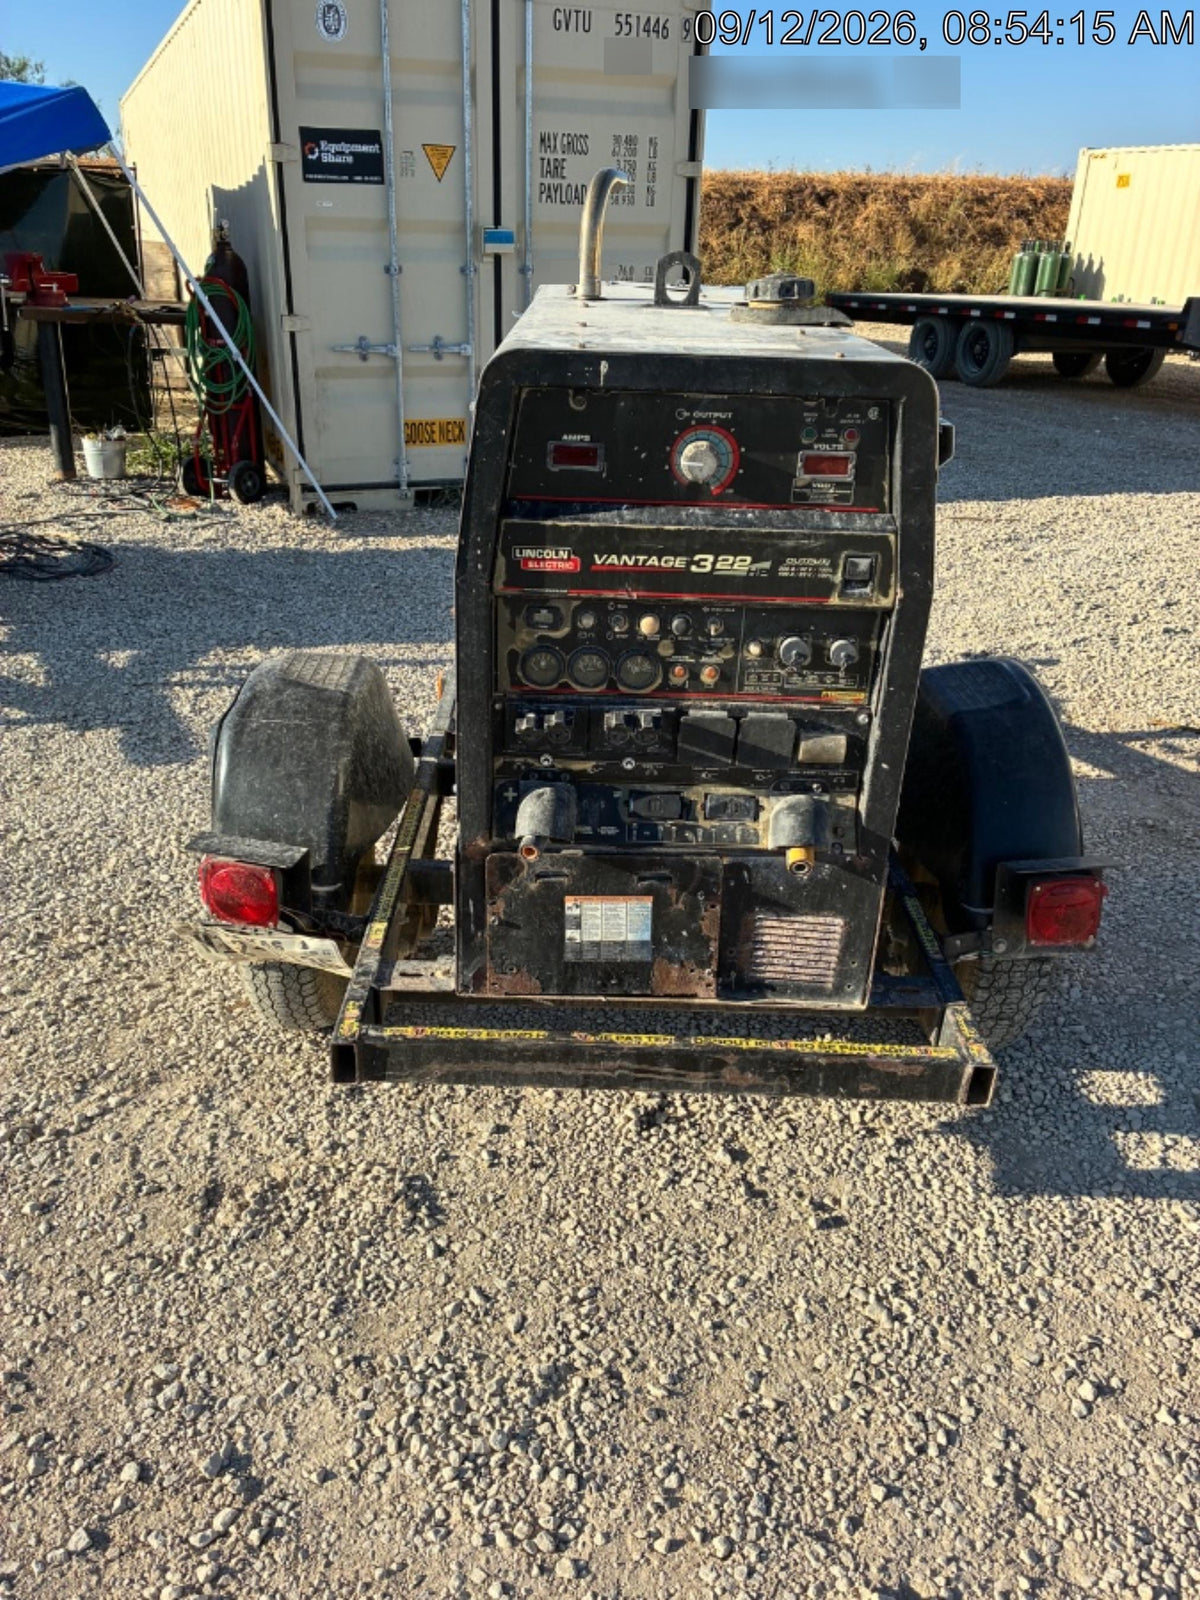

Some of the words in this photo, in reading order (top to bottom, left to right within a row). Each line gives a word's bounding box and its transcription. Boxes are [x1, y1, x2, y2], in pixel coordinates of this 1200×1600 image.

[553, 8, 592, 33] GVTU
[615, 14, 670, 40] 551446
[682, 18, 691, 40] 9
[319, 140, 381, 154] Equipment
[540, 131, 559, 153] MAX
[561, 133, 589, 156] GROSS
[321, 153, 353, 164] Share
[540, 157, 567, 179] TARE
[539, 183, 587, 205] PAYLOAD
[404, 422, 436, 444] GOOSE
[439, 421, 465, 442] NECK
[515, 549, 568, 559] LINCOLN
[593, 554, 687, 568] VANTAGE
[690, 553, 752, 573] 322
[527, 560, 575, 570] ELECTRIC
